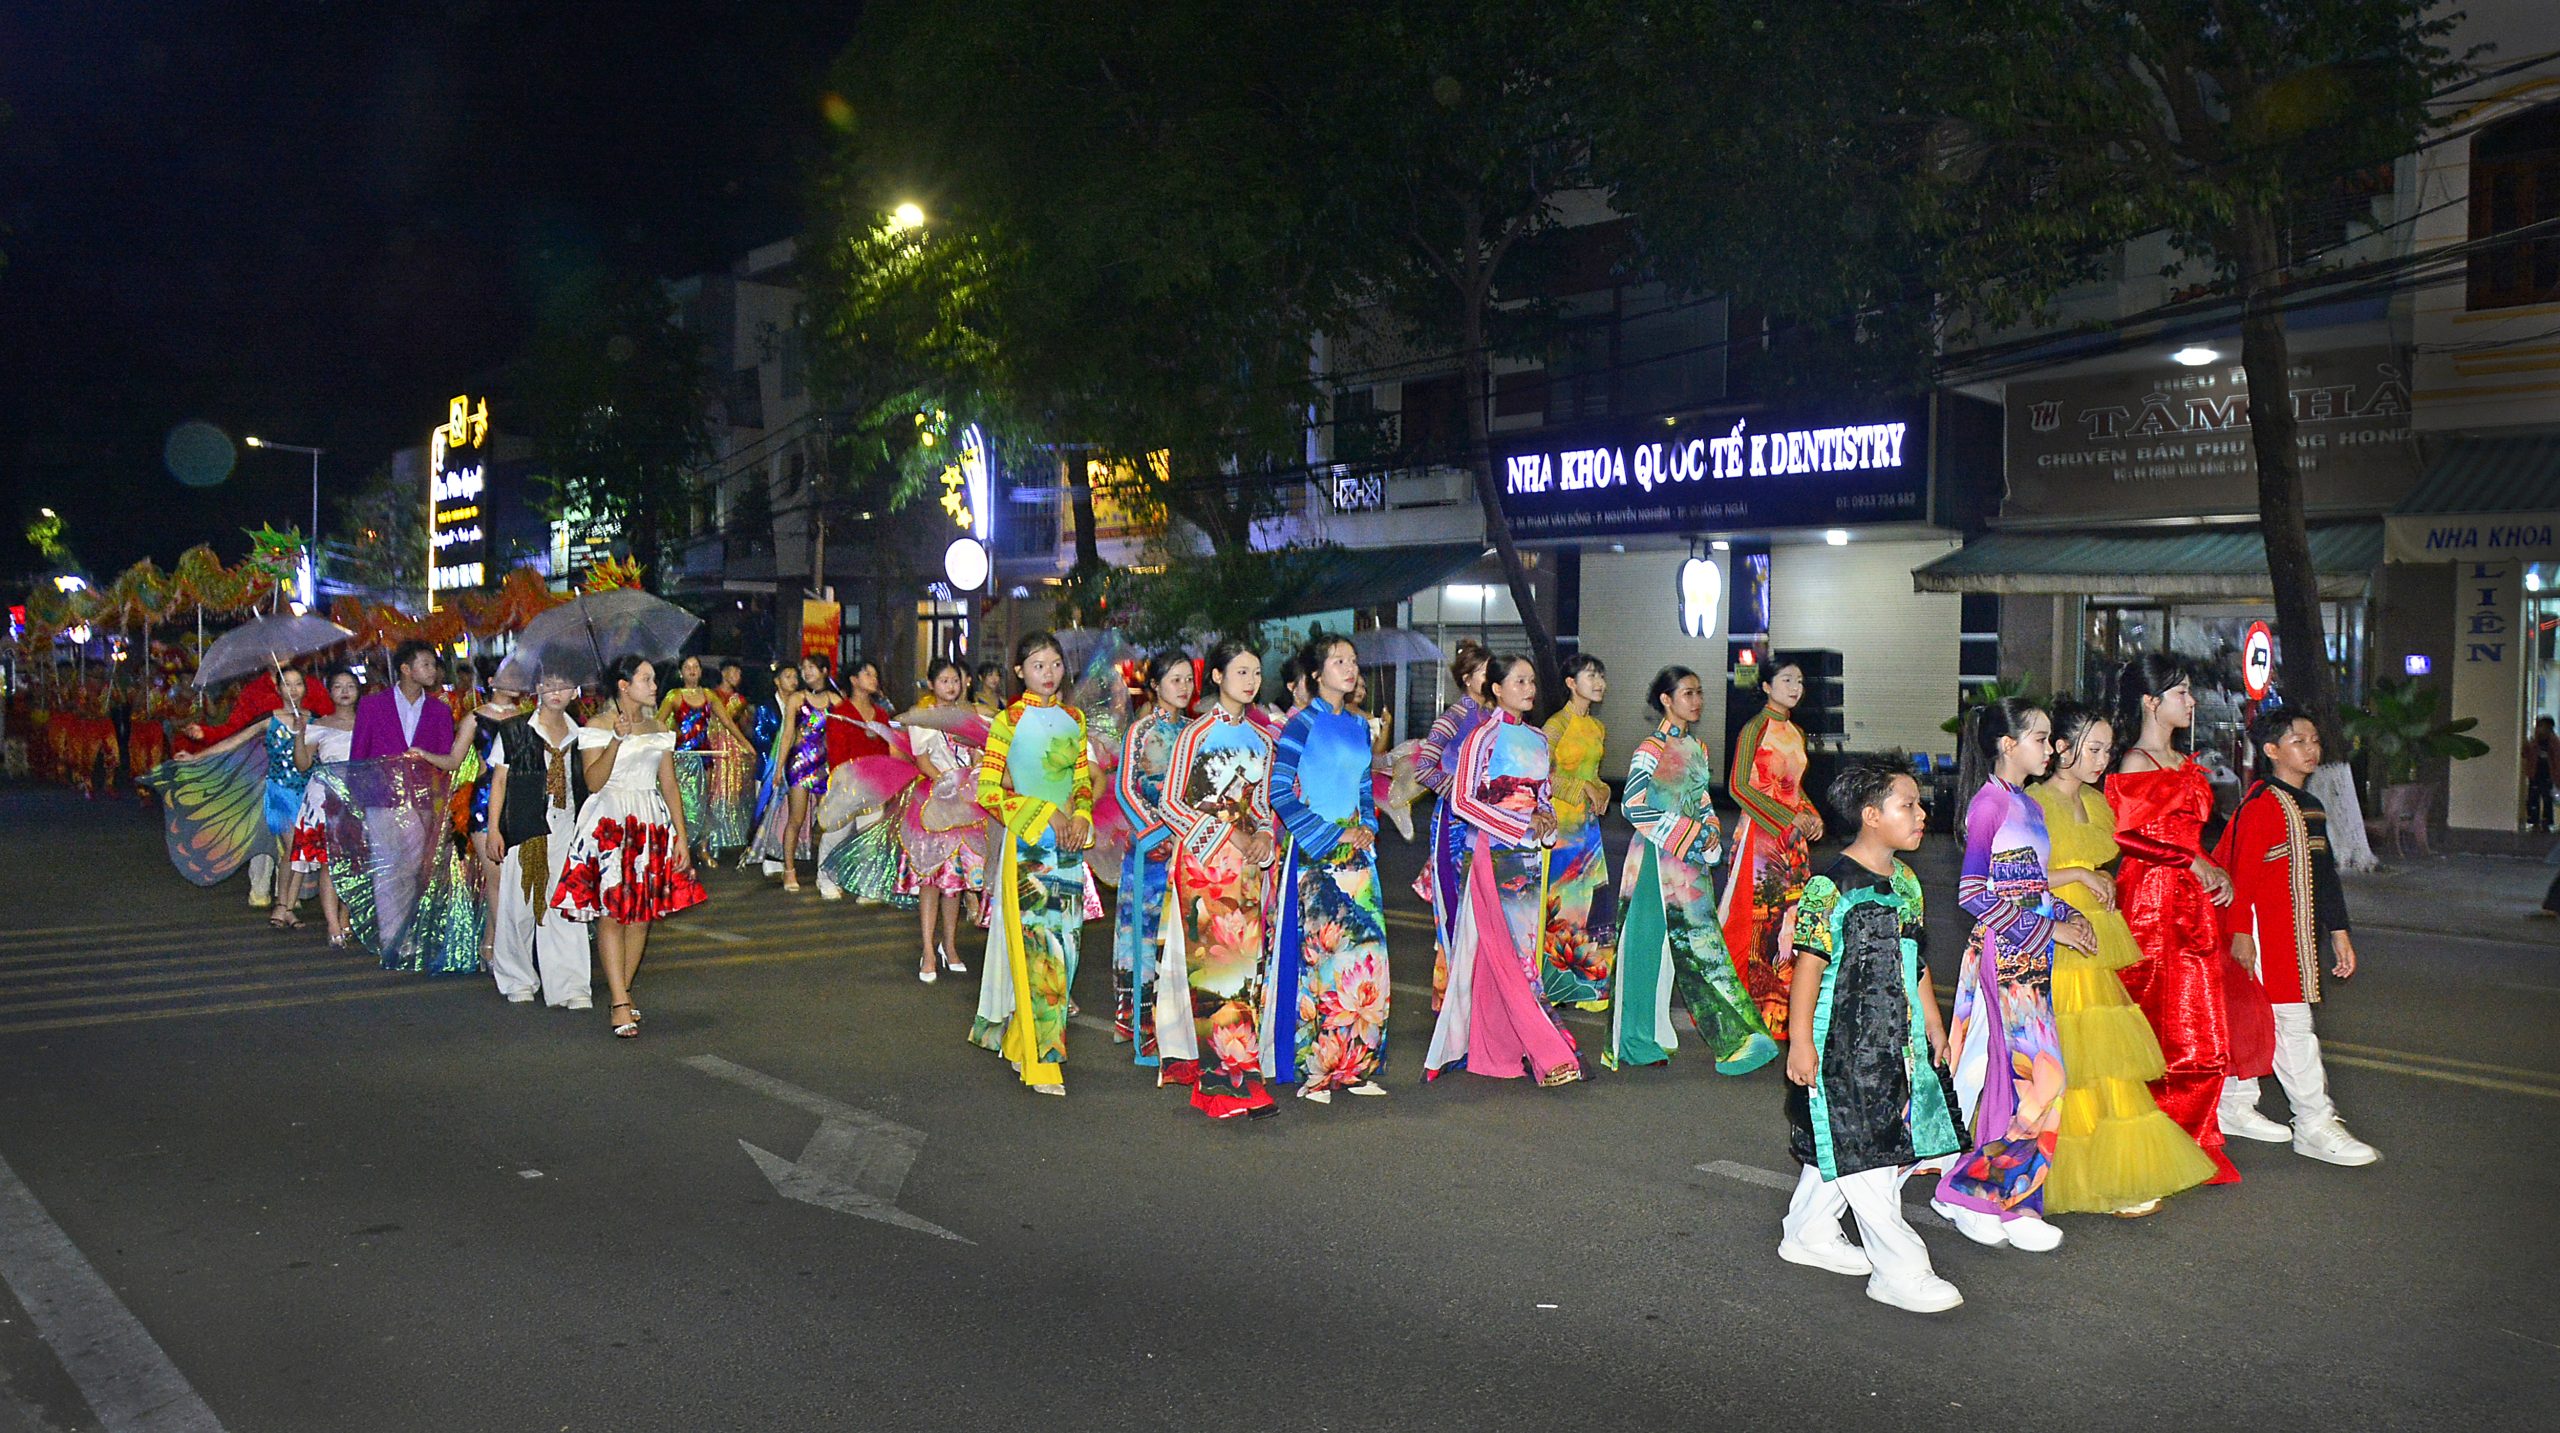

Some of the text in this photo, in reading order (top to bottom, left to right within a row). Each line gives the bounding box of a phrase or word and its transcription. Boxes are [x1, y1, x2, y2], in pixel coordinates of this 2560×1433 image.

[2076, 391, 2250, 440] TÂM
[1506, 454, 1552, 494] NHA
[1559, 446, 1627, 490] KHOA
[1709, 416, 1746, 479] TẾ
[1749, 434, 1769, 477] K
[1769, 421, 1906, 476] DENTISTRY
[2037, 447, 2127, 467] CHUYÊN
[2136, 443, 2185, 460] BÁN
[2196, 440, 2246, 457] PHỤ
[2338, 428, 2412, 446] HOND
[2425, 525, 2553, 550] NHA KHOA
